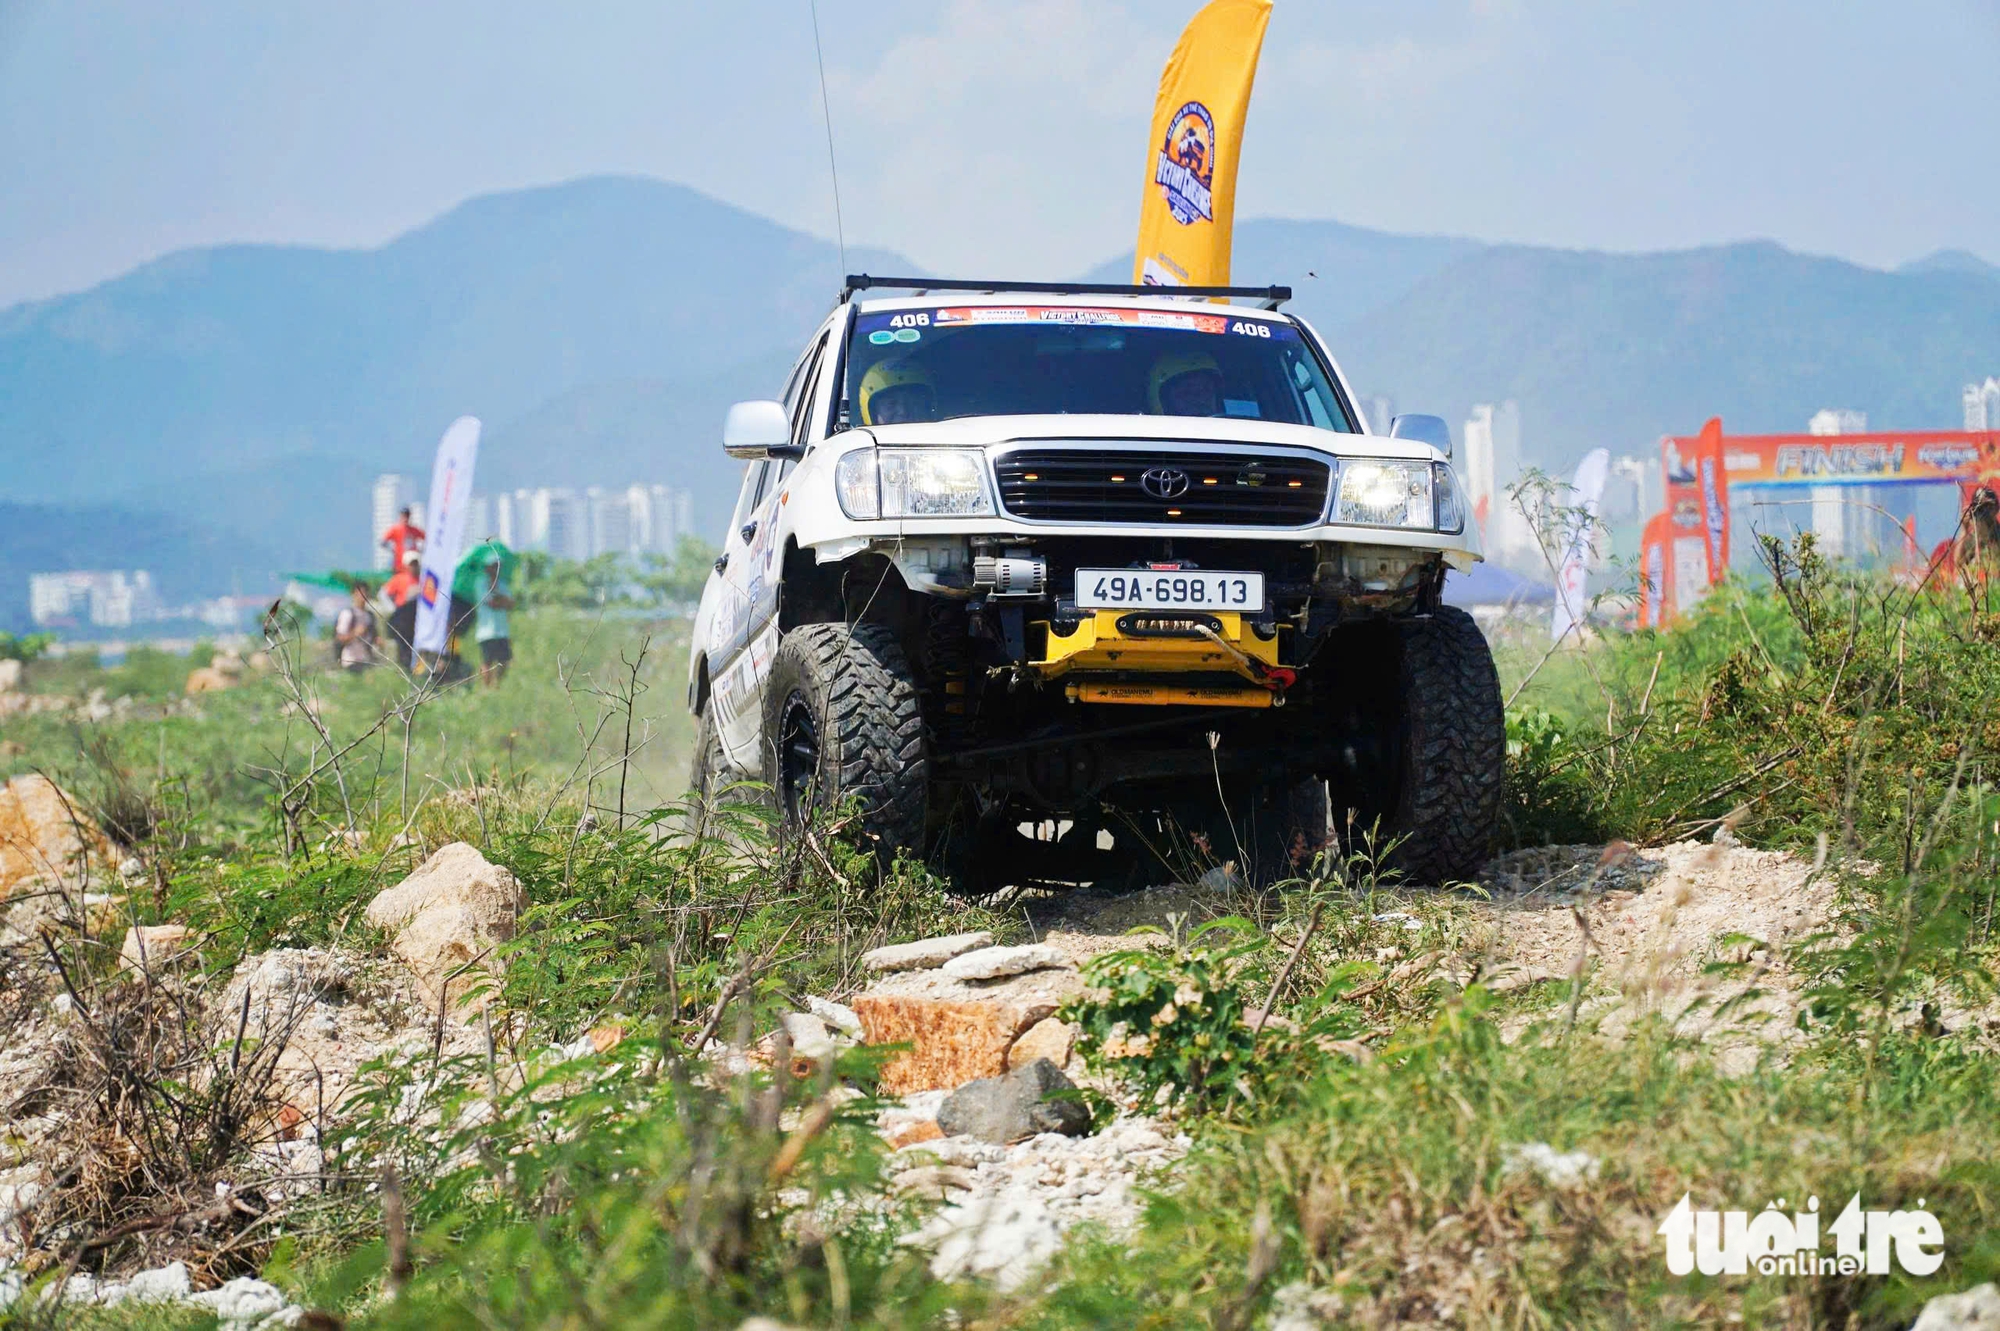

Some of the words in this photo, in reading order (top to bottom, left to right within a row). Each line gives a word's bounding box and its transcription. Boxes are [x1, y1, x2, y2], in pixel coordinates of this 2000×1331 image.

[889, 313, 930, 328] 406
[1232, 321, 1272, 338] 406
[1775, 442, 1906, 477] FINISH
[1093, 577, 1247, 604] 49A-698.13
